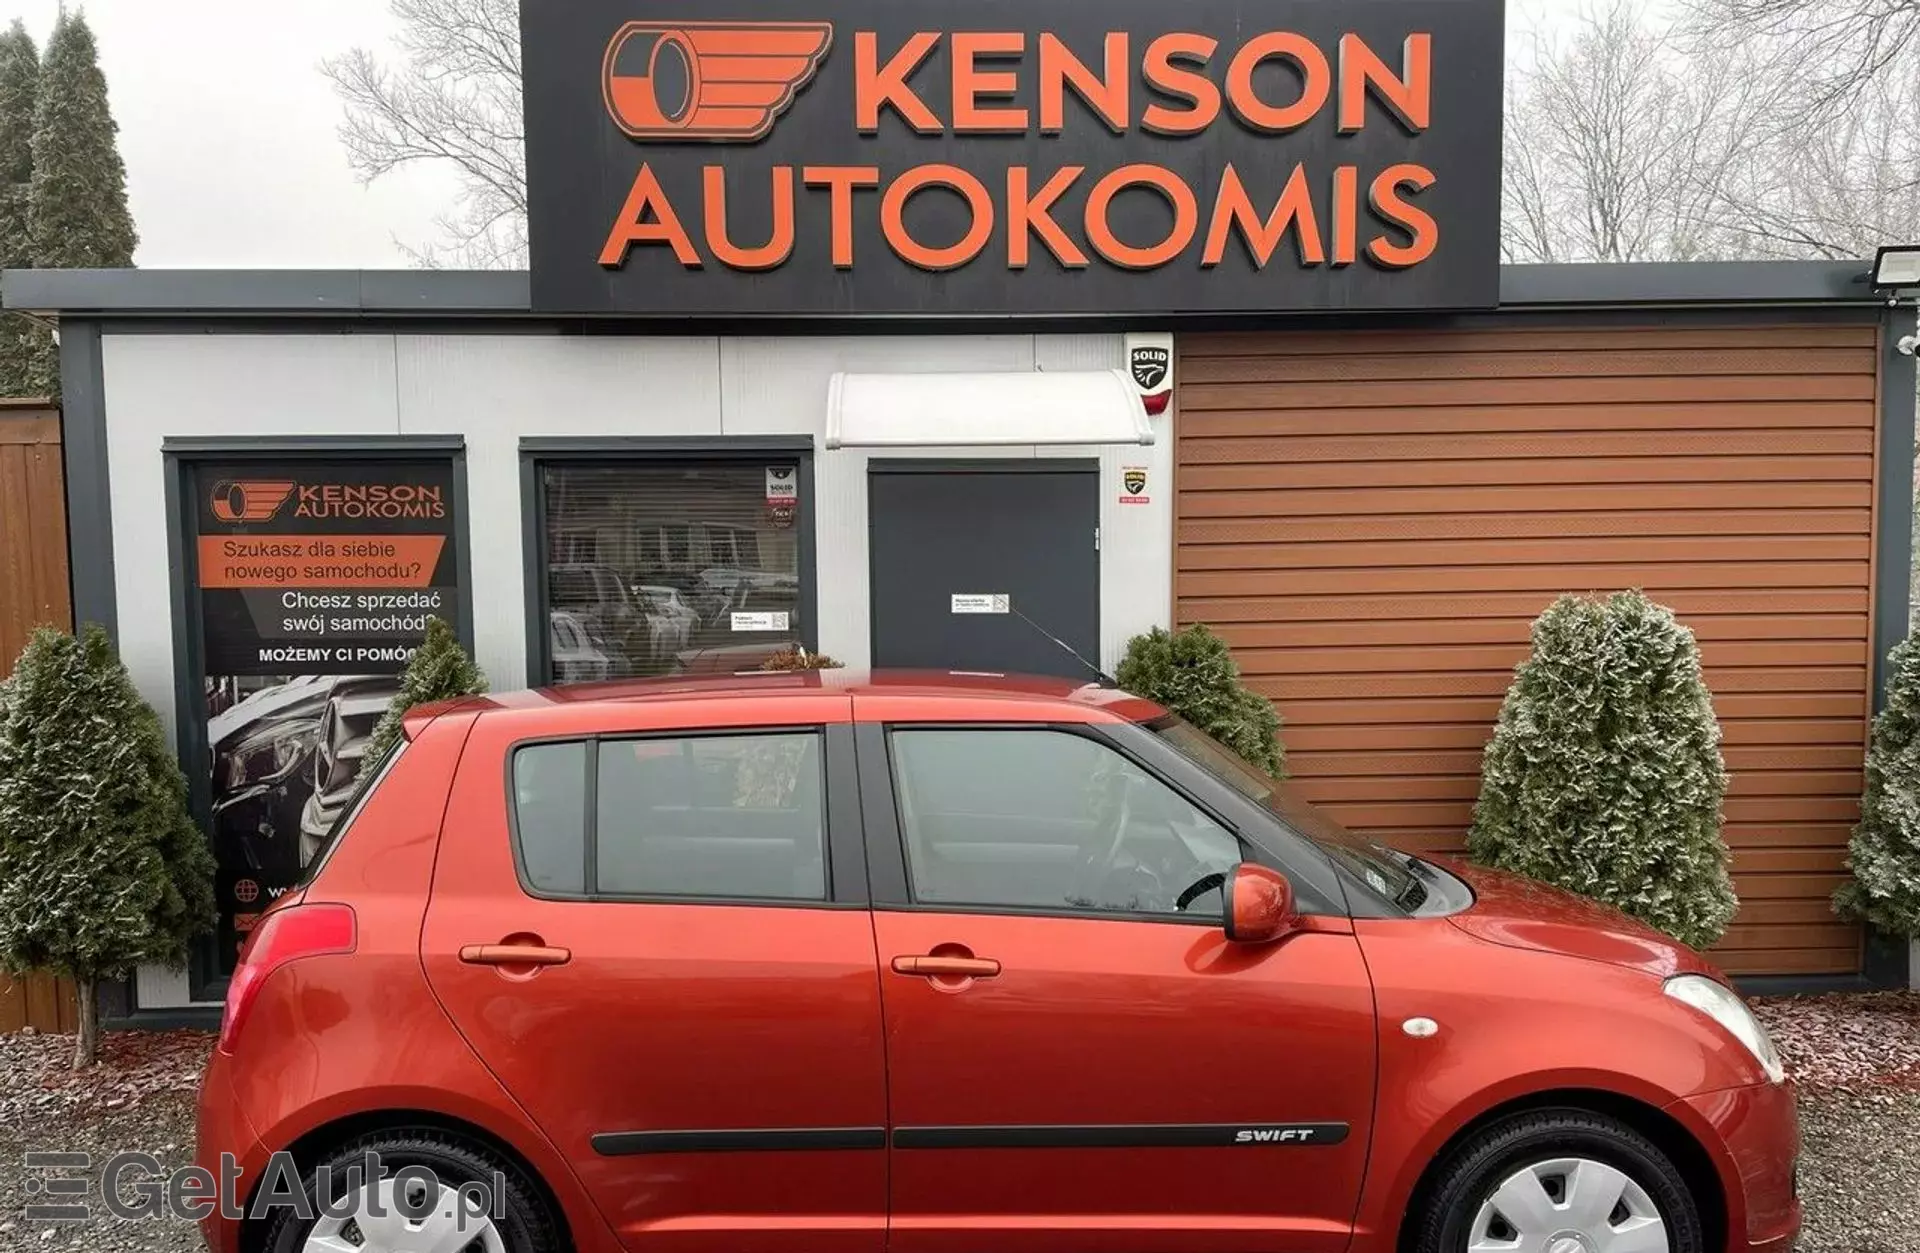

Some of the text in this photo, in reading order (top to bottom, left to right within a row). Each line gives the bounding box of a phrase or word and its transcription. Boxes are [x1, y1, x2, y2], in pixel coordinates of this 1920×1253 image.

[854, 30, 1431, 135] KENSON
[597, 161, 1440, 270] AUTOKOMIS
[1133, 351, 1167, 362] SOLID
[299, 485, 441, 502] KENSON
[294, 501, 446, 519] AUTOKOMIS
[223, 541, 396, 557] Szukasz dla siebie
[224, 562, 421, 582] nowego samochodu?
[281, 591, 441, 612] Chcesz sprzedać
[283, 614, 325, 635] swój
[259, 645, 331, 661] MOŻEMY
[335, 648, 353, 662] CI
[1235, 1129, 1314, 1142] SWIFT
